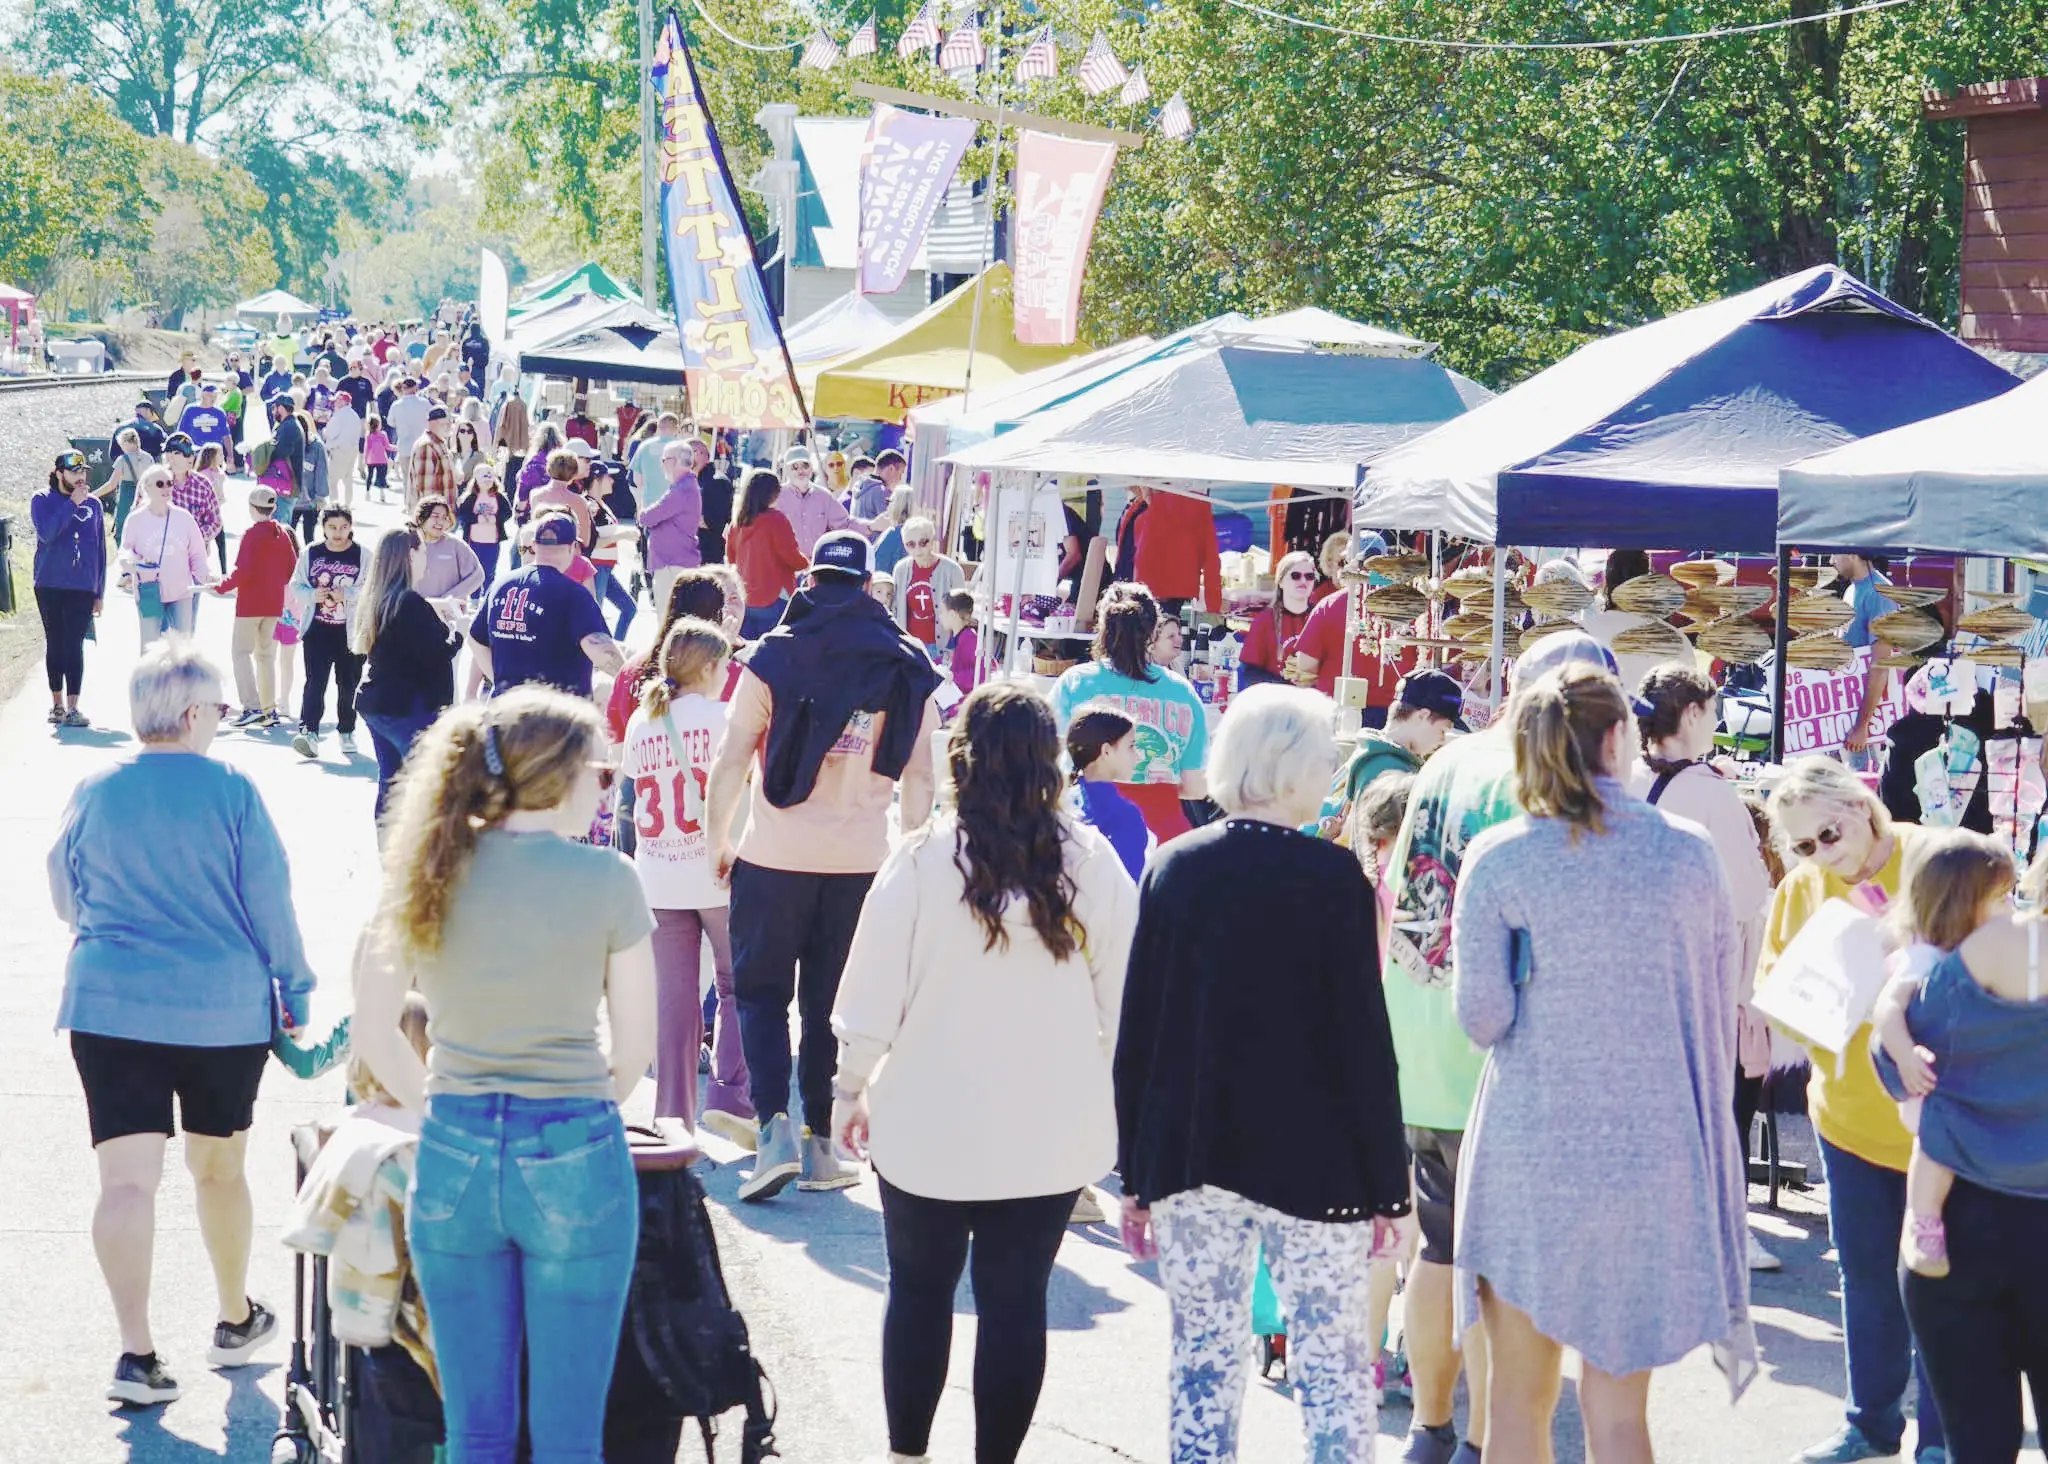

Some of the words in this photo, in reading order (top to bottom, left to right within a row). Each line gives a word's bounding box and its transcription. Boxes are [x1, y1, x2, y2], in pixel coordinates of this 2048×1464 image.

[491, 597, 544, 616] TATION
[501, 586, 530, 621] 11
[1784, 673, 1880, 721] GODFR
[1784, 720, 1816, 752] NC
[636, 767, 708, 838] 30
